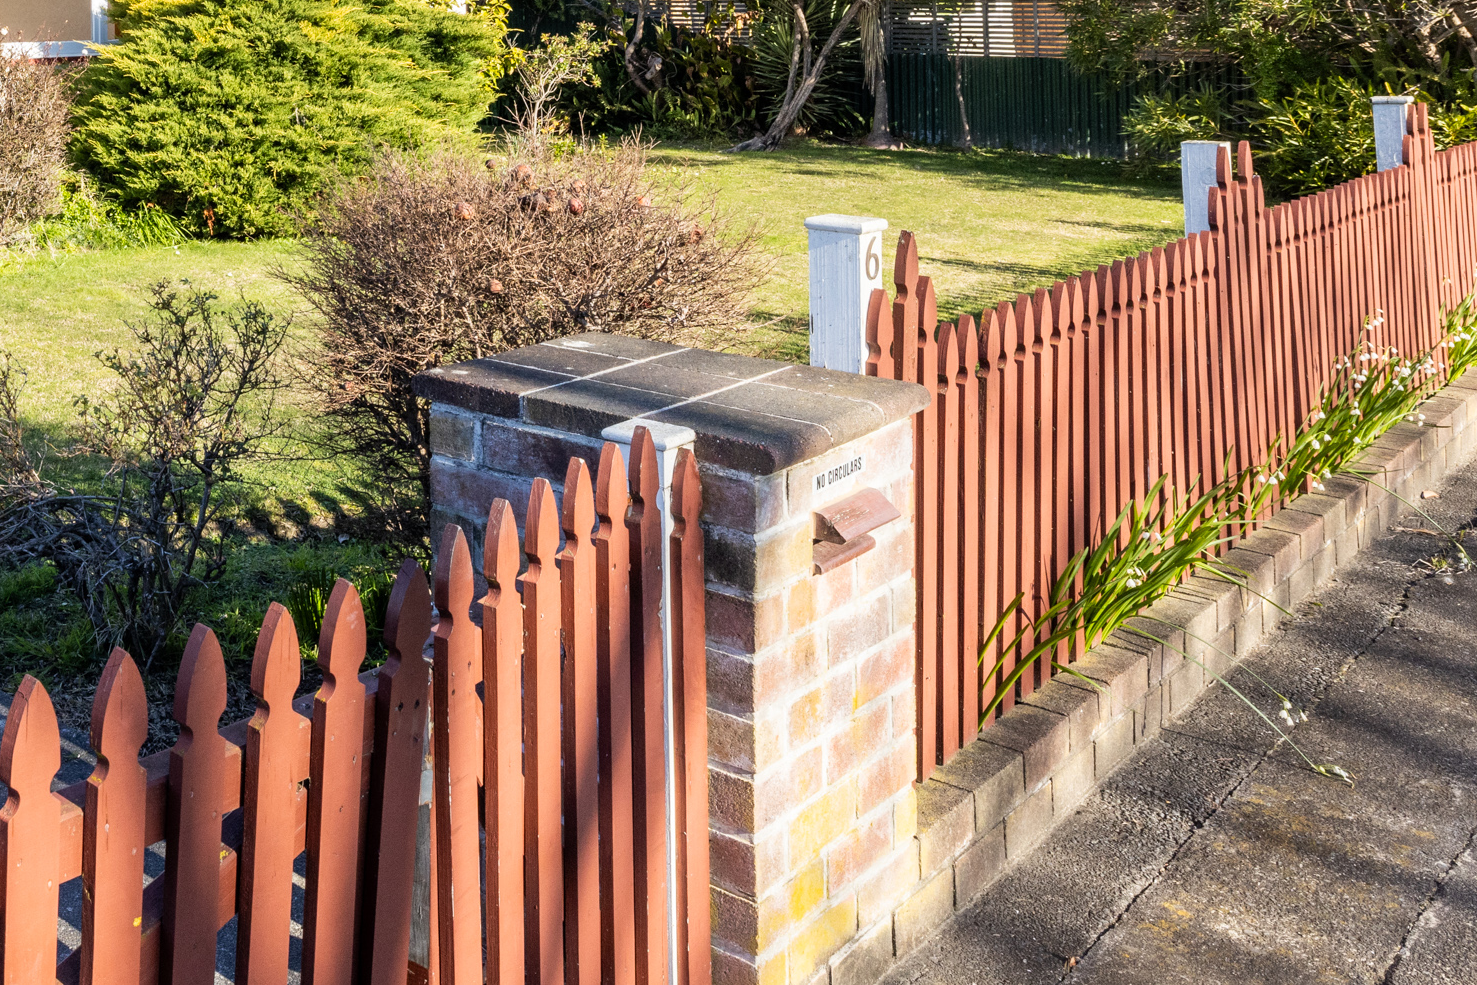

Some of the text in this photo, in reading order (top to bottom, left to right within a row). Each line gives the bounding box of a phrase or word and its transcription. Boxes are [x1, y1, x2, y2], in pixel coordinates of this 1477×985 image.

[865, 236, 879, 281] 6
[816, 456, 862, 490] NO CIRCULARS
